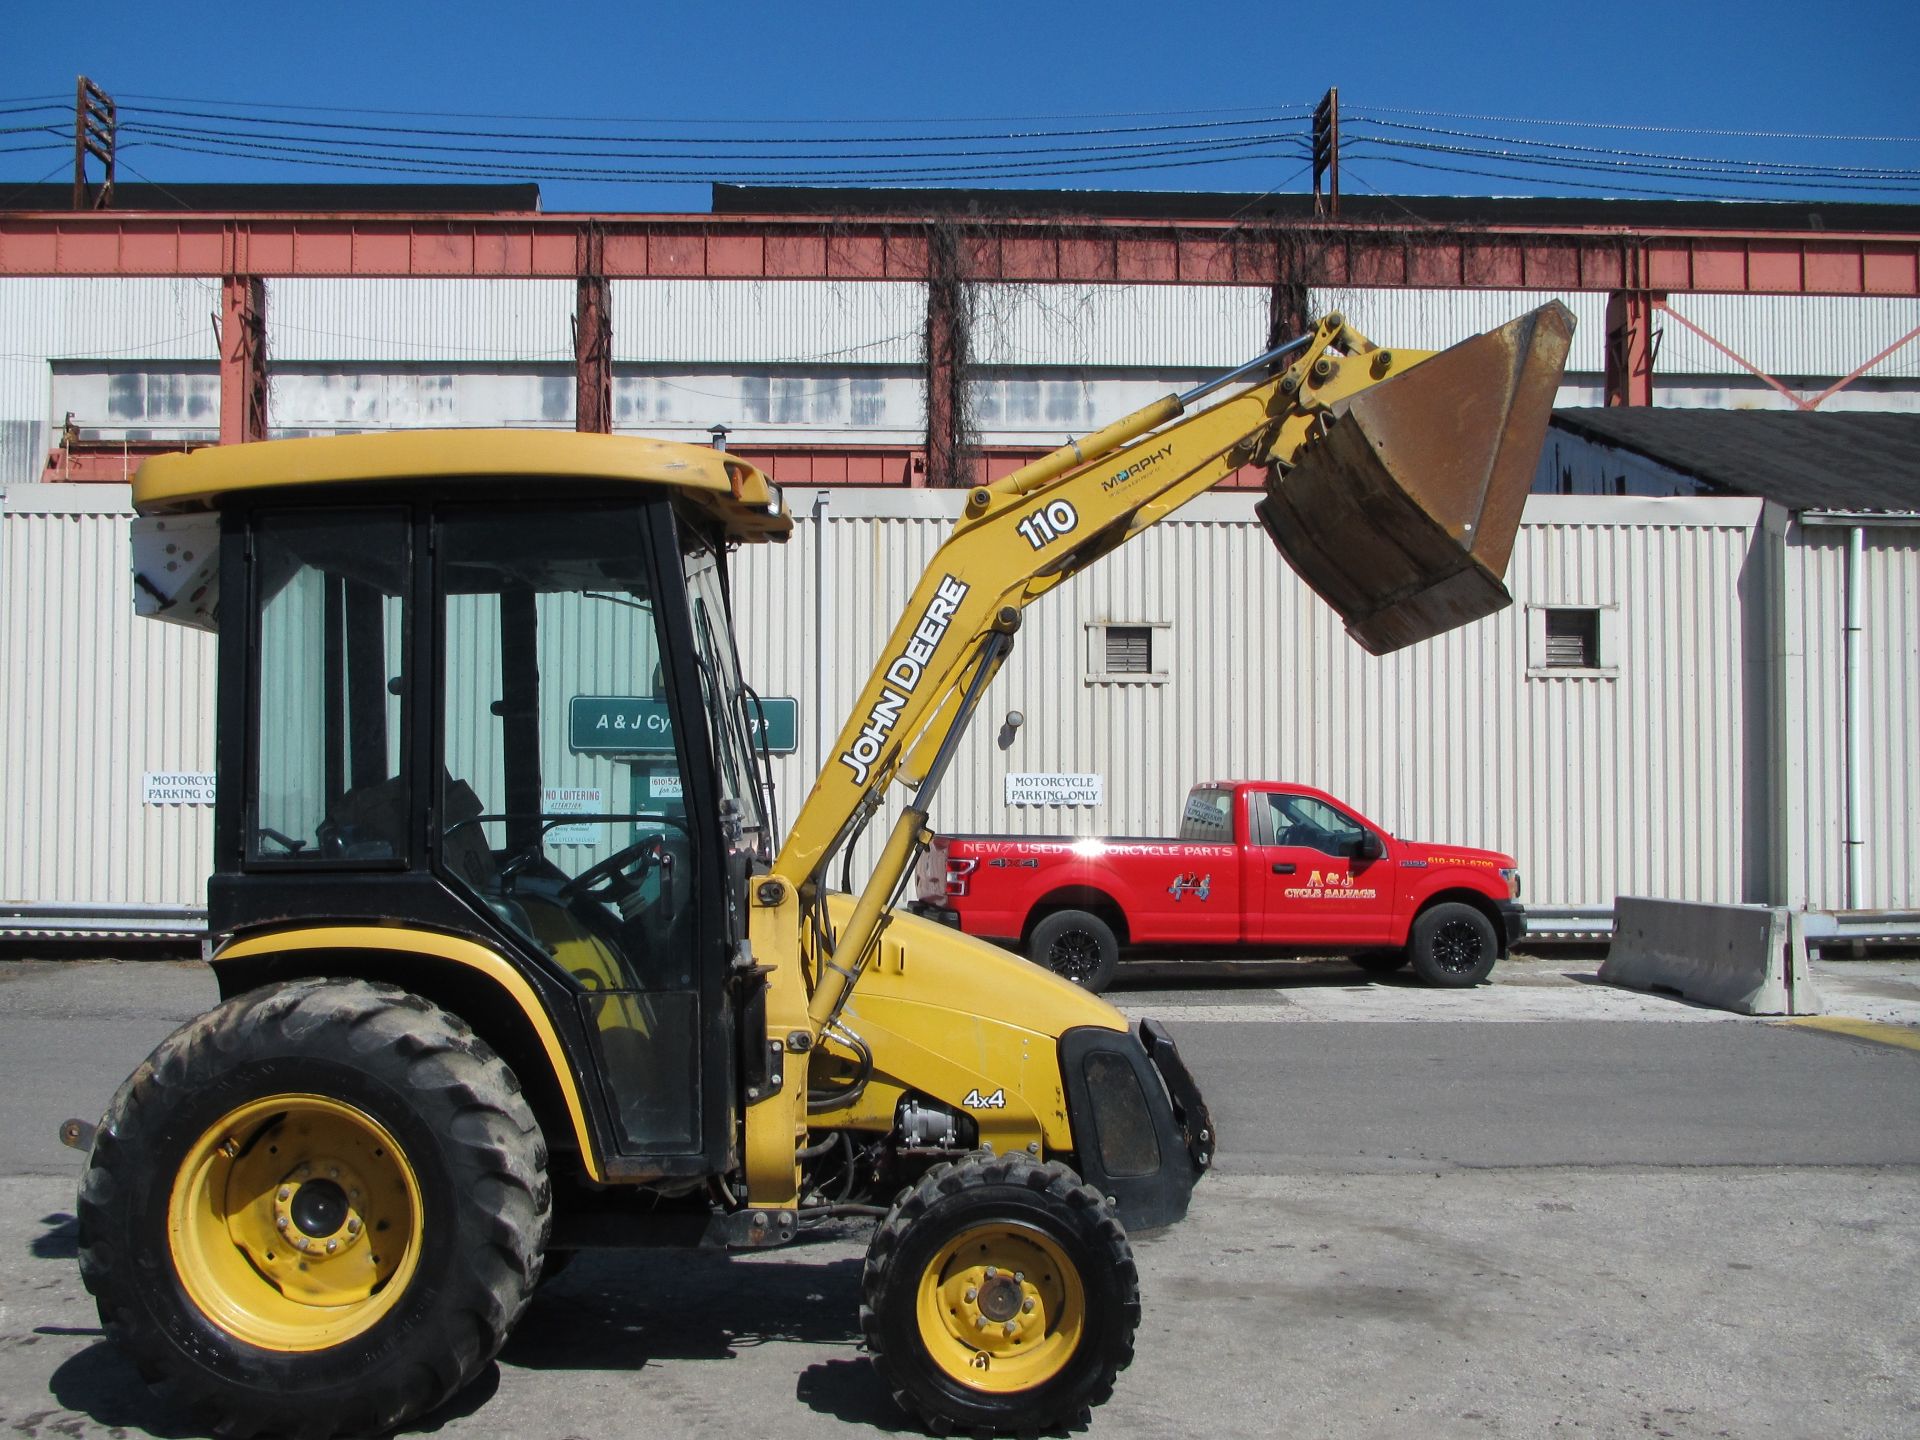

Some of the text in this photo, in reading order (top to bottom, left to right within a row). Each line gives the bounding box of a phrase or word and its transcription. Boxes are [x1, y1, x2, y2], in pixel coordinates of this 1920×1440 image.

[1015, 498, 1079, 552] 110
[839, 573, 971, 787] JOHN DEERE
[596, 715, 609, 729] A
[614, 715, 626, 729] &
[631, 715, 642, 729] J
[647, 715, 672, 733] Cy
[1014, 777, 1094, 787] MOTORCYCLE
[148, 789, 216, 799] PARKING O
[545, 790, 600, 801] NO LOITERING
[1011, 790, 1099, 801] PARKING ONLY
[963, 843, 1000, 853] NEW
[1017, 843, 1063, 854] USED
[1184, 845, 1233, 857] PARTS
[1427, 856, 1494, 868] 610-521-6700
[1307, 870, 1354, 888] A & J
[1284, 888, 1376, 899] CYCLE SALVAGE
[962, 1088, 1006, 1109] 4x4
